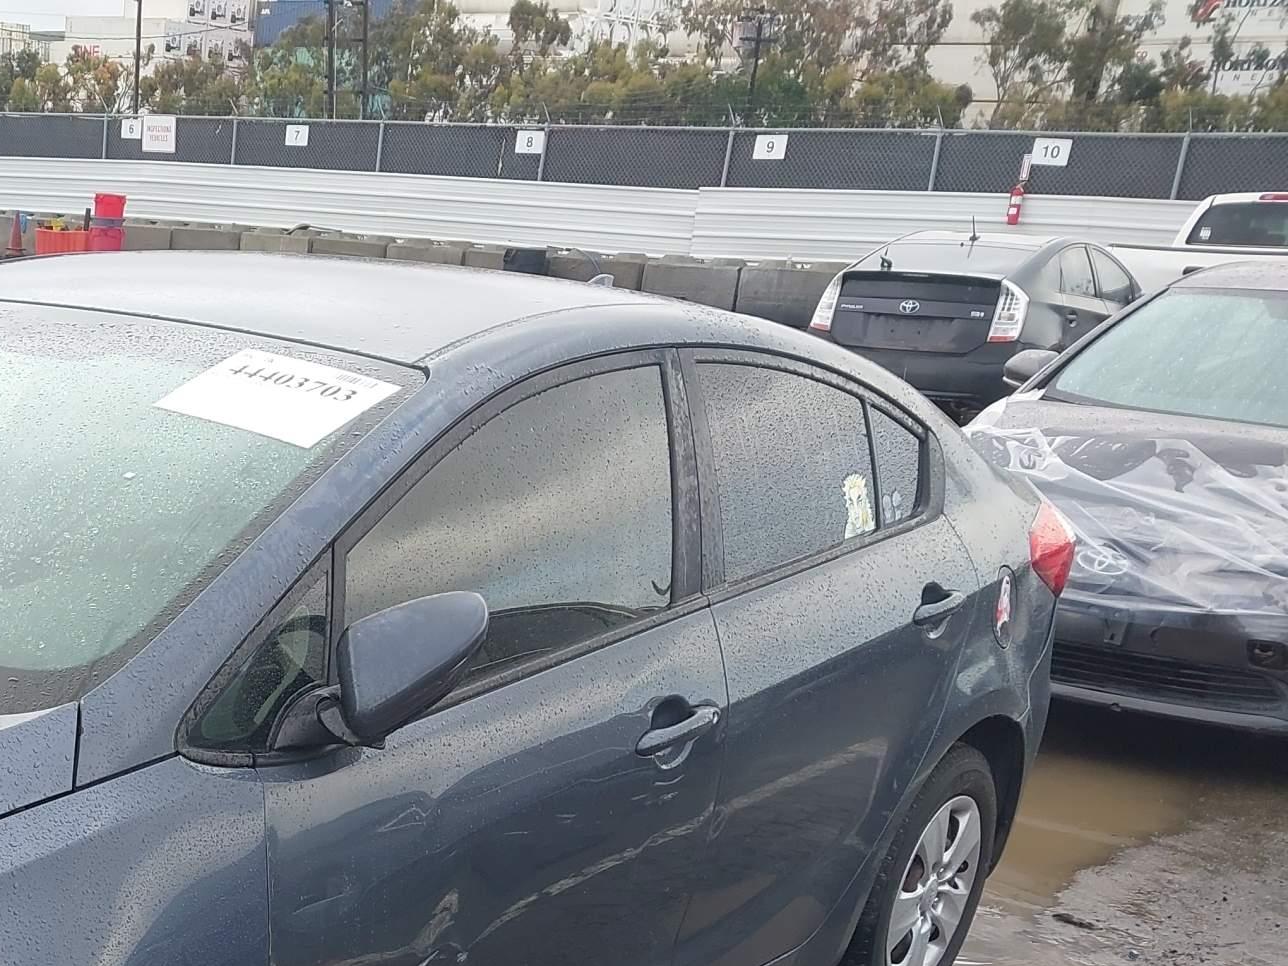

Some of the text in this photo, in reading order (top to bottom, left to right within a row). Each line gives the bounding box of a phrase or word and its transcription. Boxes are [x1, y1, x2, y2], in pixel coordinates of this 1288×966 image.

[128, 124, 134, 134] 6
[294, 130, 300, 141] 7
[526, 136, 533, 148] 8
[766, 140, 774, 153] 9
[1042, 145, 1060, 158] 10
[228, 364, 357, 401] 44403703
